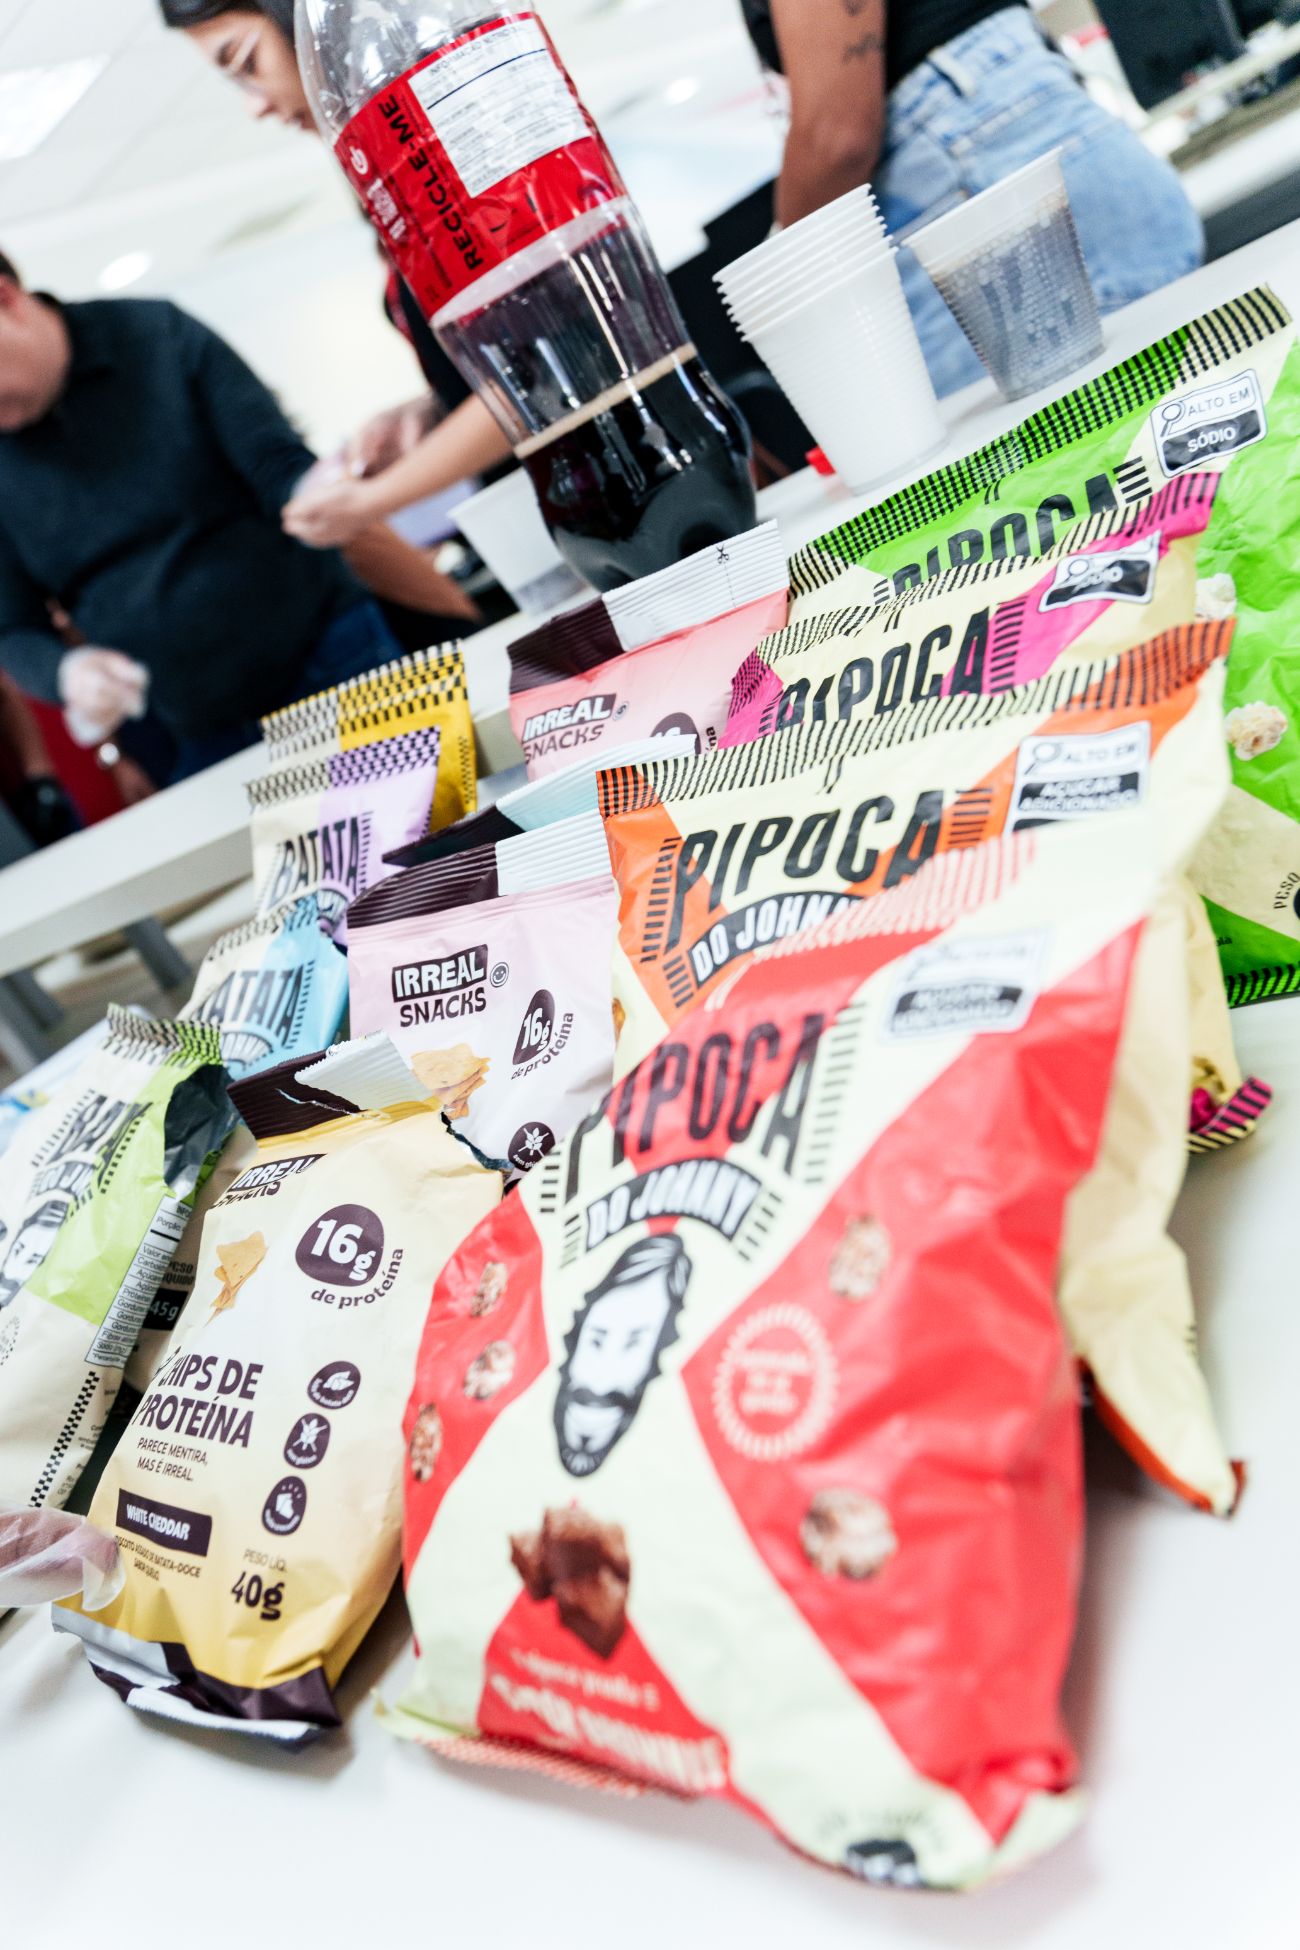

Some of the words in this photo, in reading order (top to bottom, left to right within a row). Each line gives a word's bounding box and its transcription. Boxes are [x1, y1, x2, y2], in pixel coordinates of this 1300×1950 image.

[378, 93, 484, 271] RECICLE-ME
[1187, 397, 1225, 417] ALTO
[1228, 386, 1250, 405] EM
[1186, 426, 1237, 453] SÓDIO
[522, 696, 612, 742] IRREAL
[523, 723, 605, 765] SNACKS
[664, 789, 945, 955] PIPOCA
[394, 951, 486, 999] IRREAL
[691, 922, 730, 983] DO
[195, 964, 304, 1047] ATATA
[399, 987, 487, 1028] SNACKS
[520, 1007, 552, 1051] 16g
[523, 1012, 575, 1078] proteína
[311, 1218, 377, 1282] 16g
[310, 1288, 335, 1305] de
[338, 1248, 404, 1310] proteína
[218, 1358, 264, 1400] DE
[132, 1392, 255, 1449] PROTEÍNA
[137, 1437, 168, 1457] PARECE
[168, 1444, 209, 1466] MENTIRA,
[137, 1458, 154, 1474] MAS
[155, 1459, 163, 1475] É
[126, 1503, 148, 1526] WHITE
[148, 1512, 191, 1541] CHEDDAR
[243, 1548, 267, 1566] PESO
[231, 1571, 286, 1622] 40g
